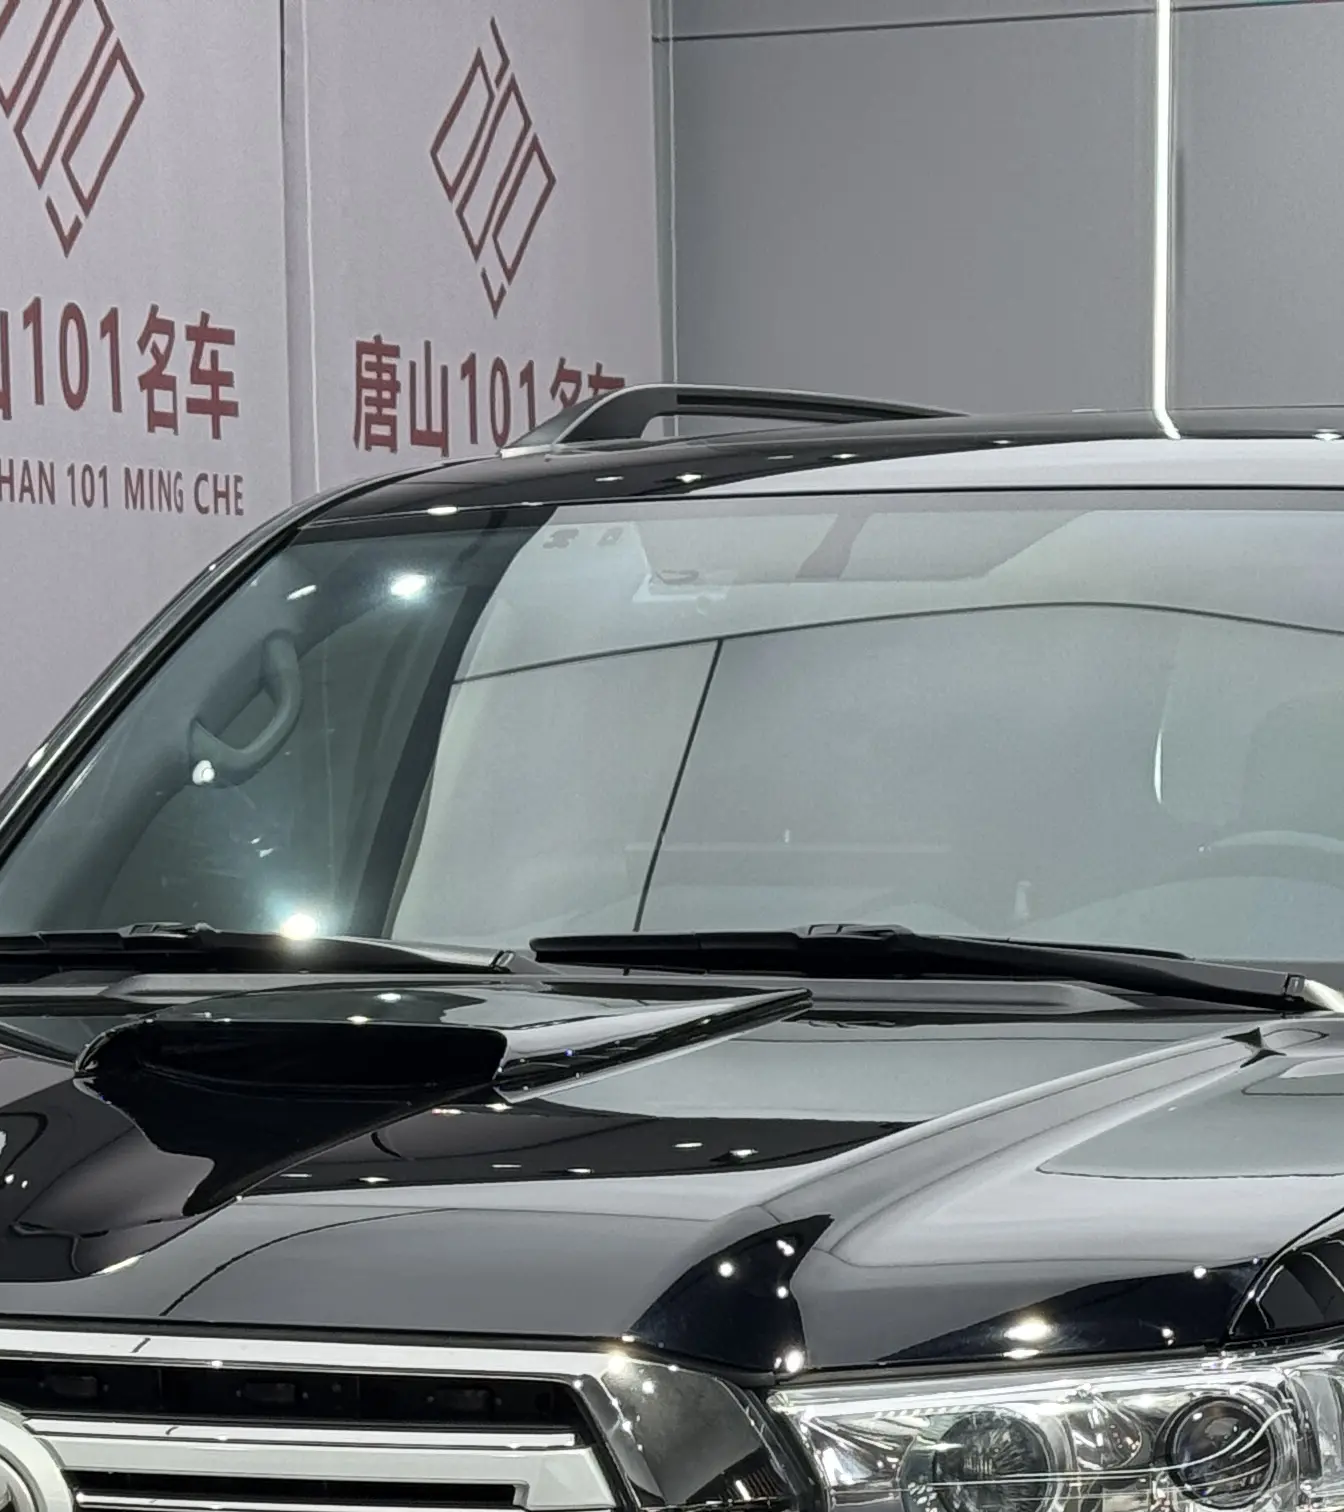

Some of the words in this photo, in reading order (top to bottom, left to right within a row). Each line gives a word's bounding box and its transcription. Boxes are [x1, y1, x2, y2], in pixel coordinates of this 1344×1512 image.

[352, 334, 625, 457] 唐山101
[66, 463, 109, 509] 101
[124, 466, 184, 514] MING
[193, 472, 244, 517] CHE
